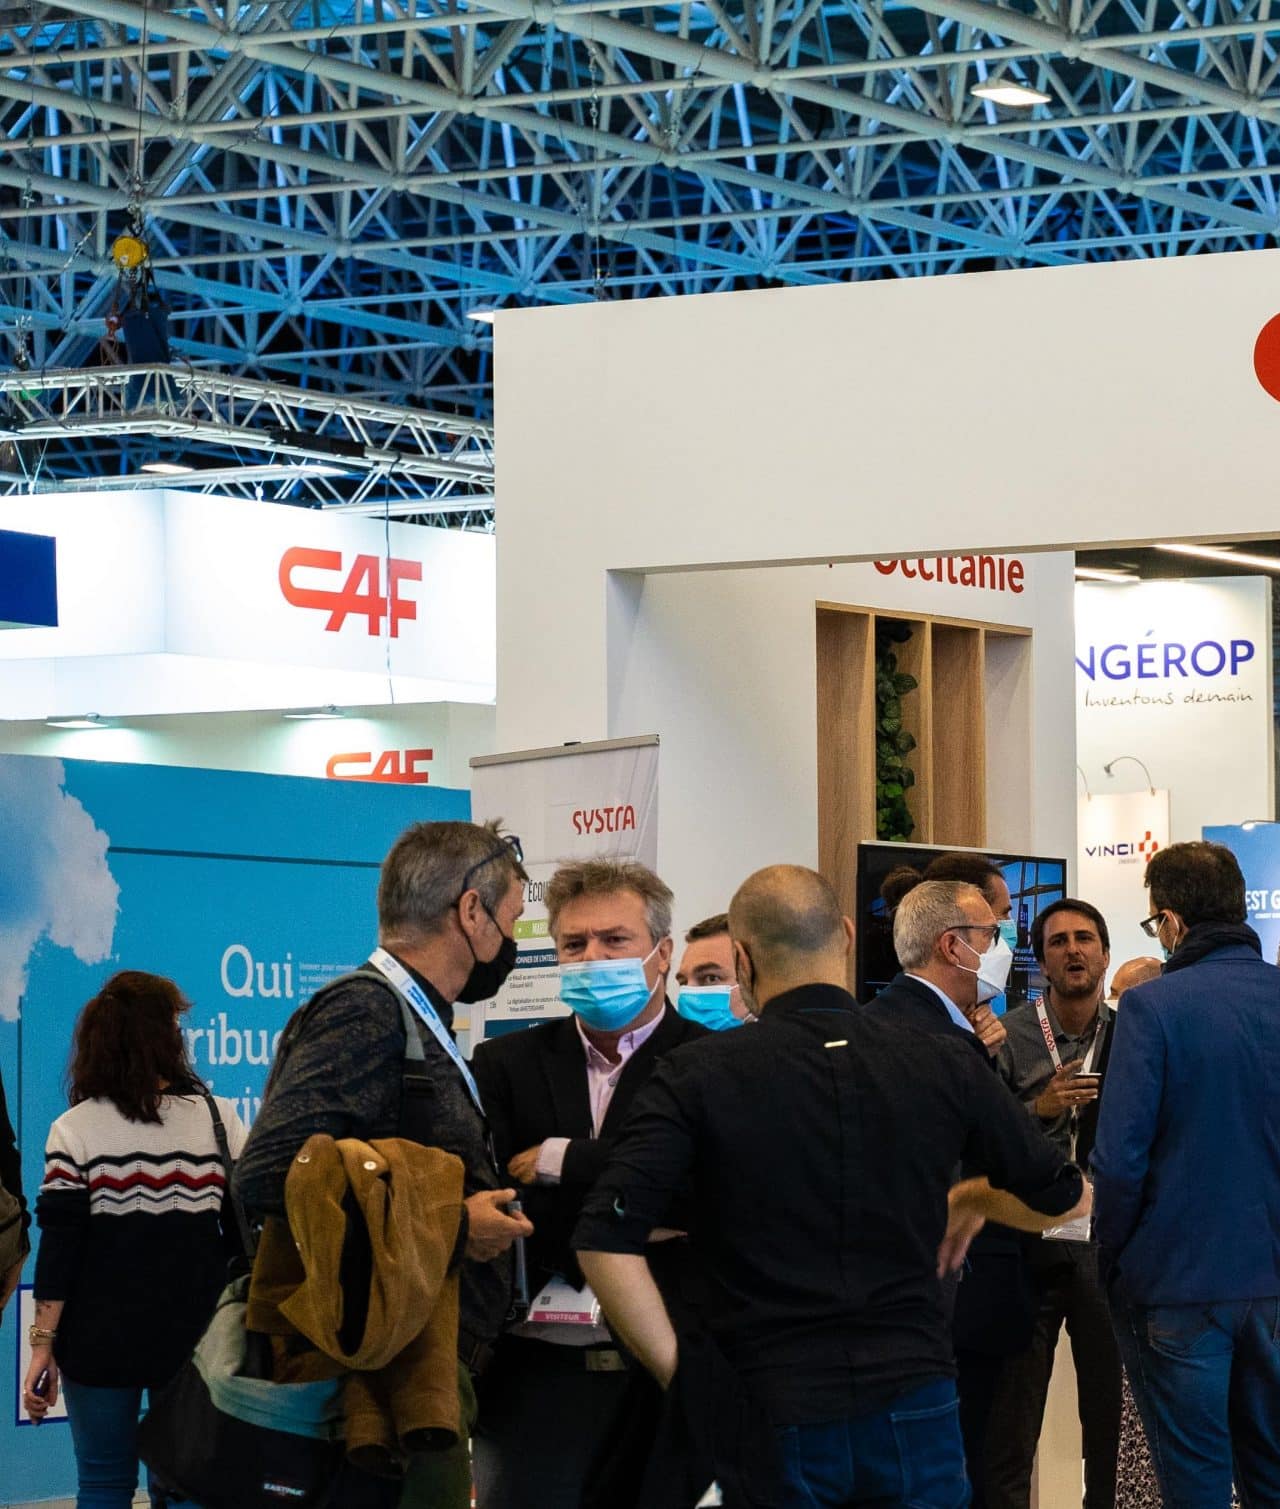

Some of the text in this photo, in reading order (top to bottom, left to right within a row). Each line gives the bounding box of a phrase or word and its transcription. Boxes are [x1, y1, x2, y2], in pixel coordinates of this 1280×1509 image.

[279, 546, 422, 638] CAF
[1075, 630, 1255, 681] NGÉROP
[1085, 686, 1253, 707] Inventons demain
[326, 749, 433, 784] CAF
[573, 805, 635, 835] SYSTRA
[1086, 843, 1134, 856] VINCI
[1246, 889, 1269, 910] EST
[221, 944, 294, 998] Qui
[182, 1013, 284, 1065] ribu
